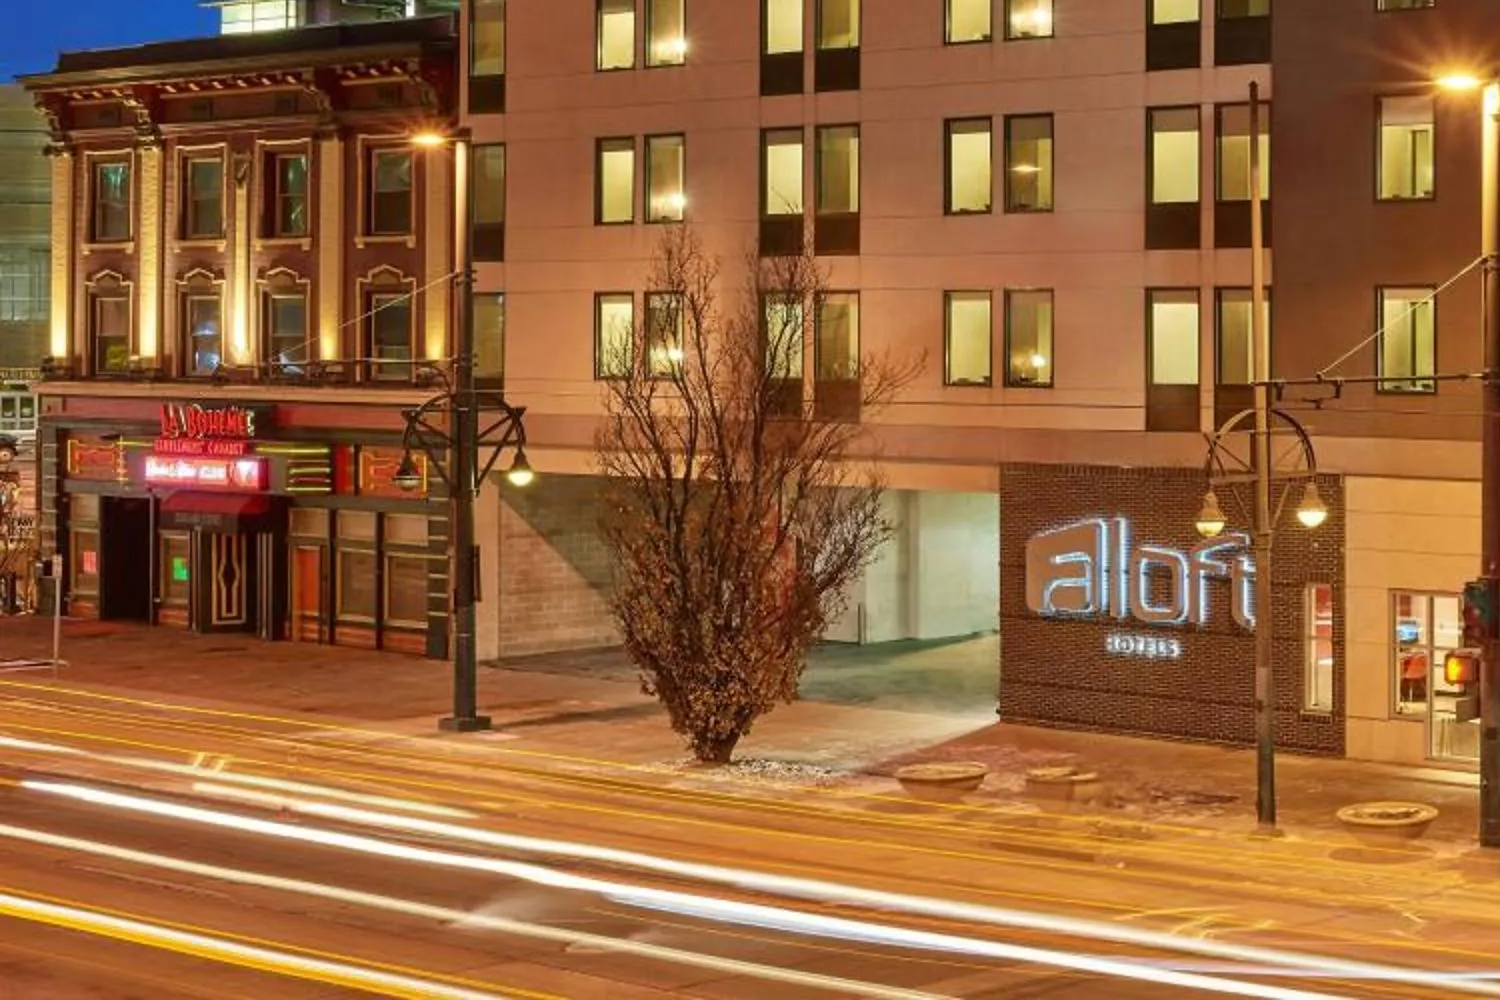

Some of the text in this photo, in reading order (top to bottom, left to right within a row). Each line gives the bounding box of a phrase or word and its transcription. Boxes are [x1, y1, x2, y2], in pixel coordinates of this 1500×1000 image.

[158, 402, 179, 438] LA
[1025, 517, 1257, 627] aloft
[1106, 635, 1181, 658] HOTELS
